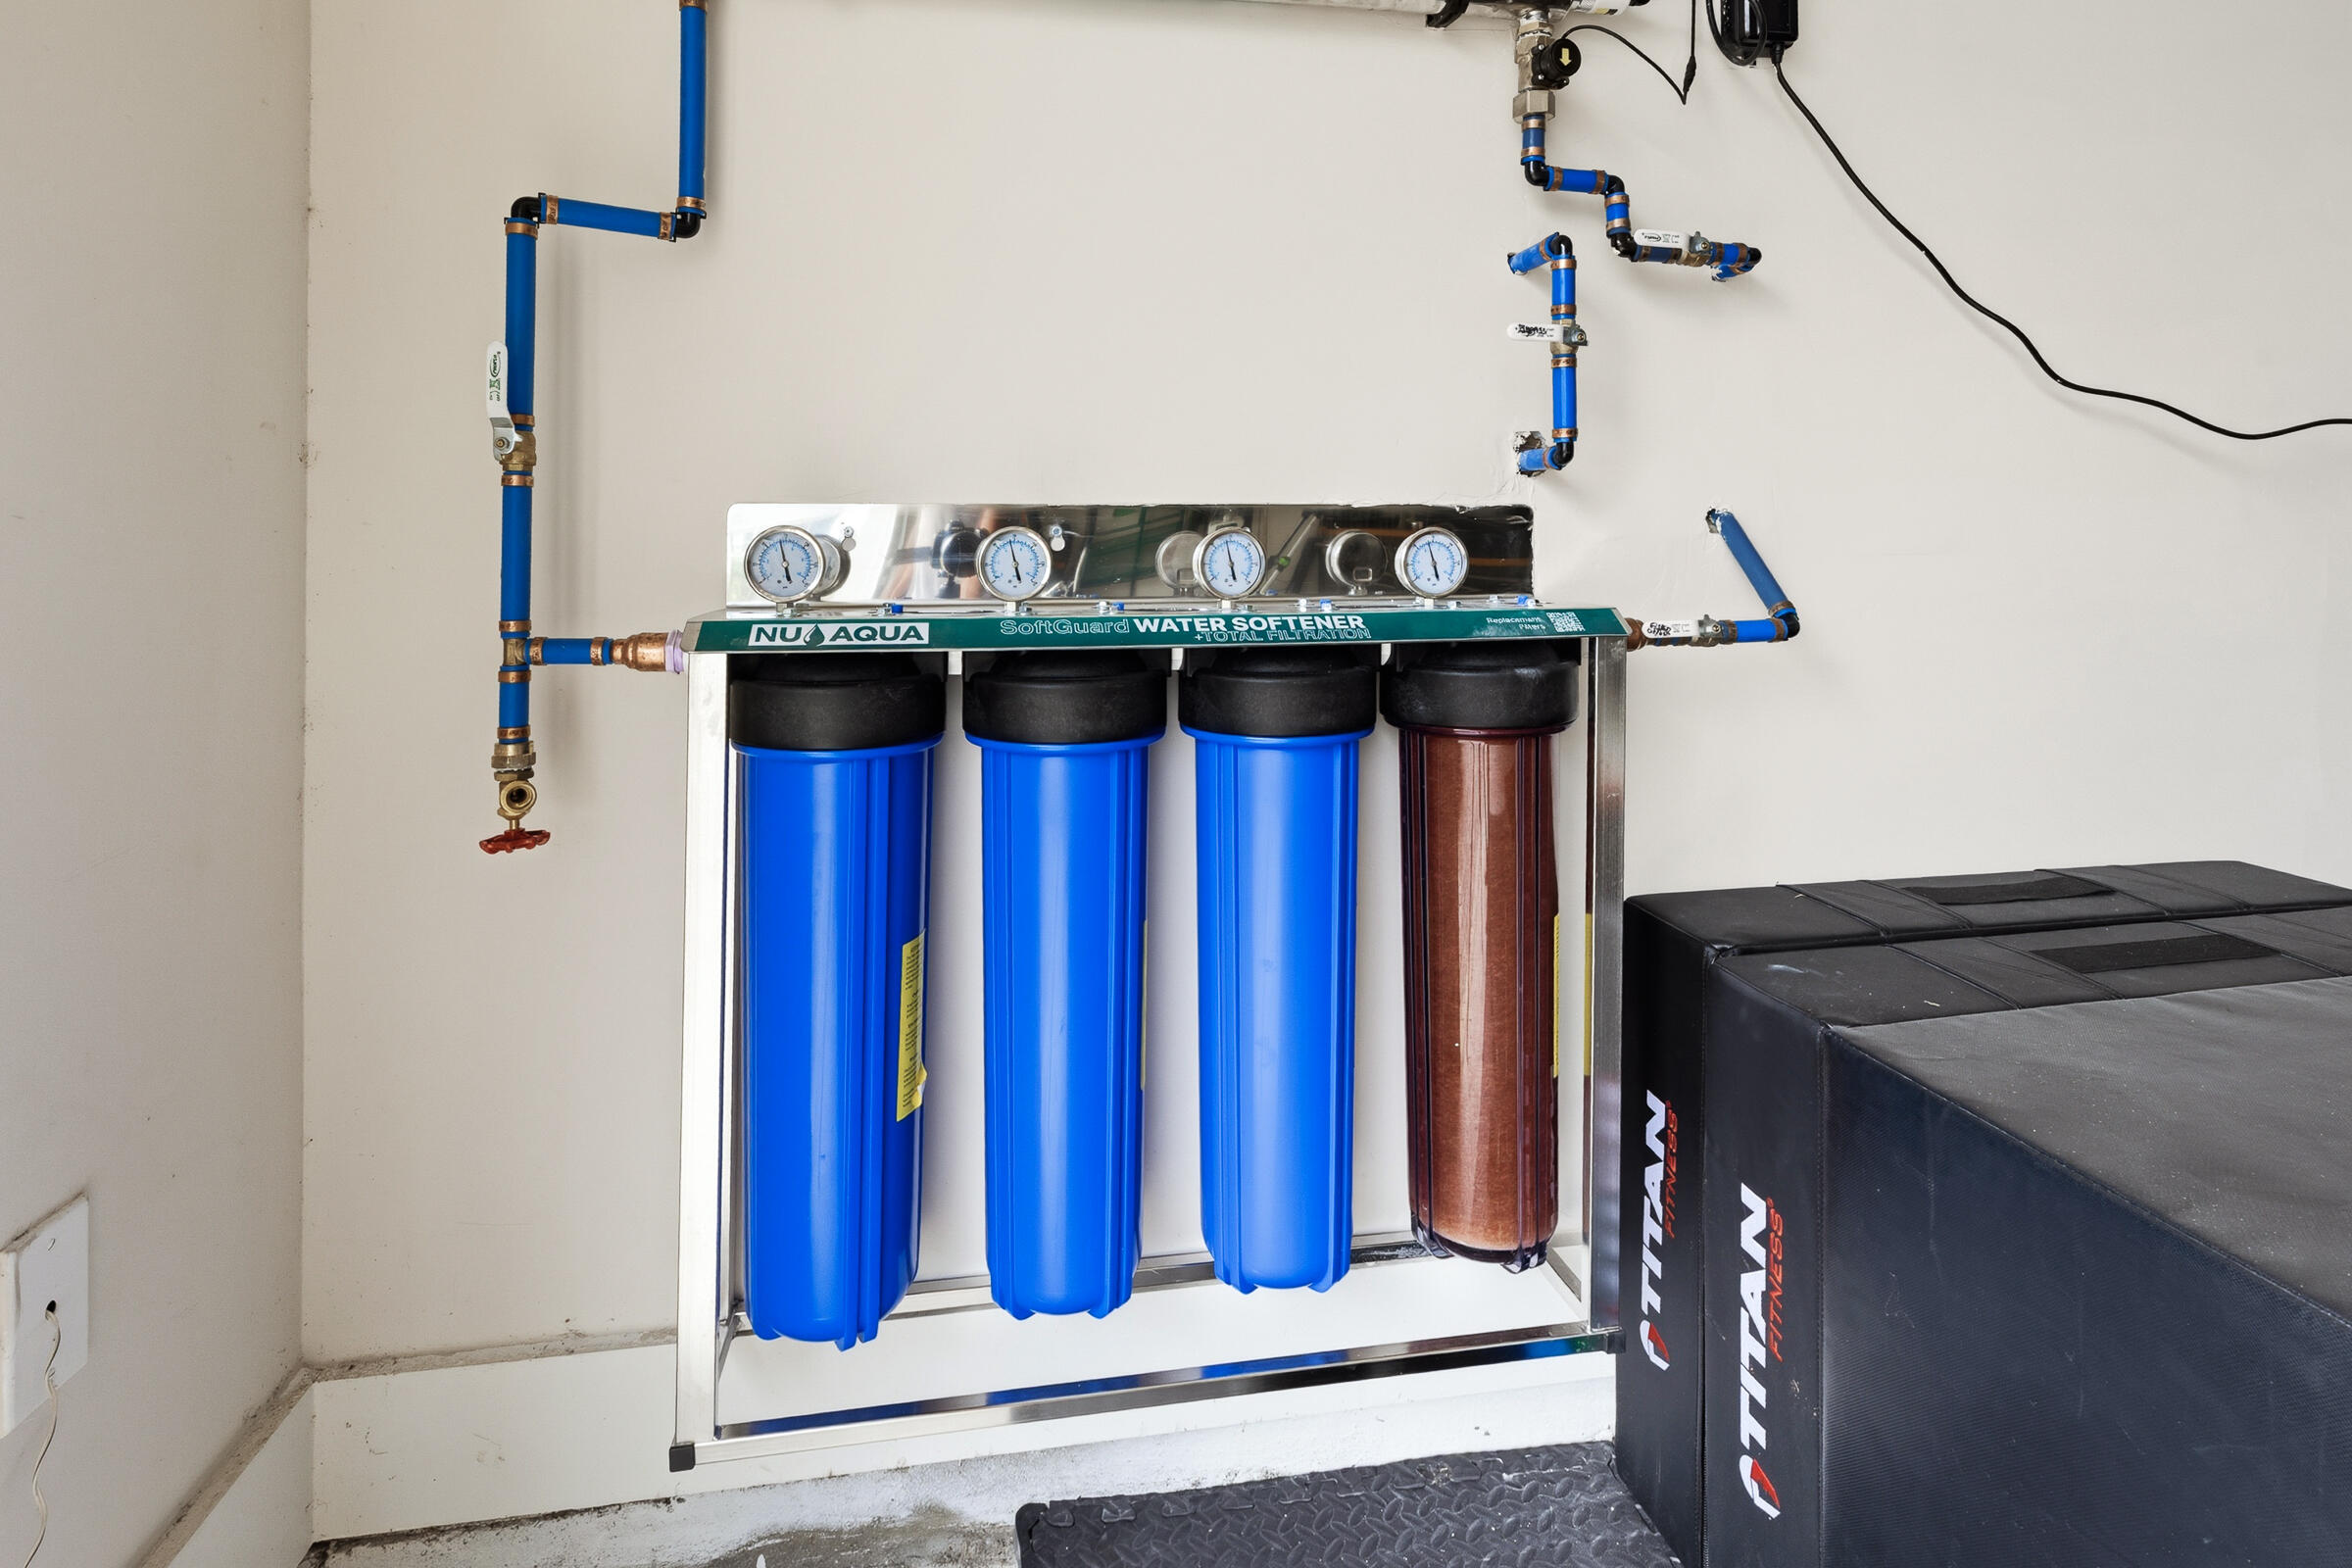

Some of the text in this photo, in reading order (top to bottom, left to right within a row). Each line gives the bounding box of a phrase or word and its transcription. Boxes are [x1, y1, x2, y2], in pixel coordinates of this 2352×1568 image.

[755, 625, 924, 642] NU AQUA
[1001, 615, 1367, 635] SoftGuard WATER SOFTENER
[1267, 628, 1372, 641] FILTRATION
[1642, 1090, 1666, 1314] TITAN
[1740, 1182, 1766, 1450] TITAN
